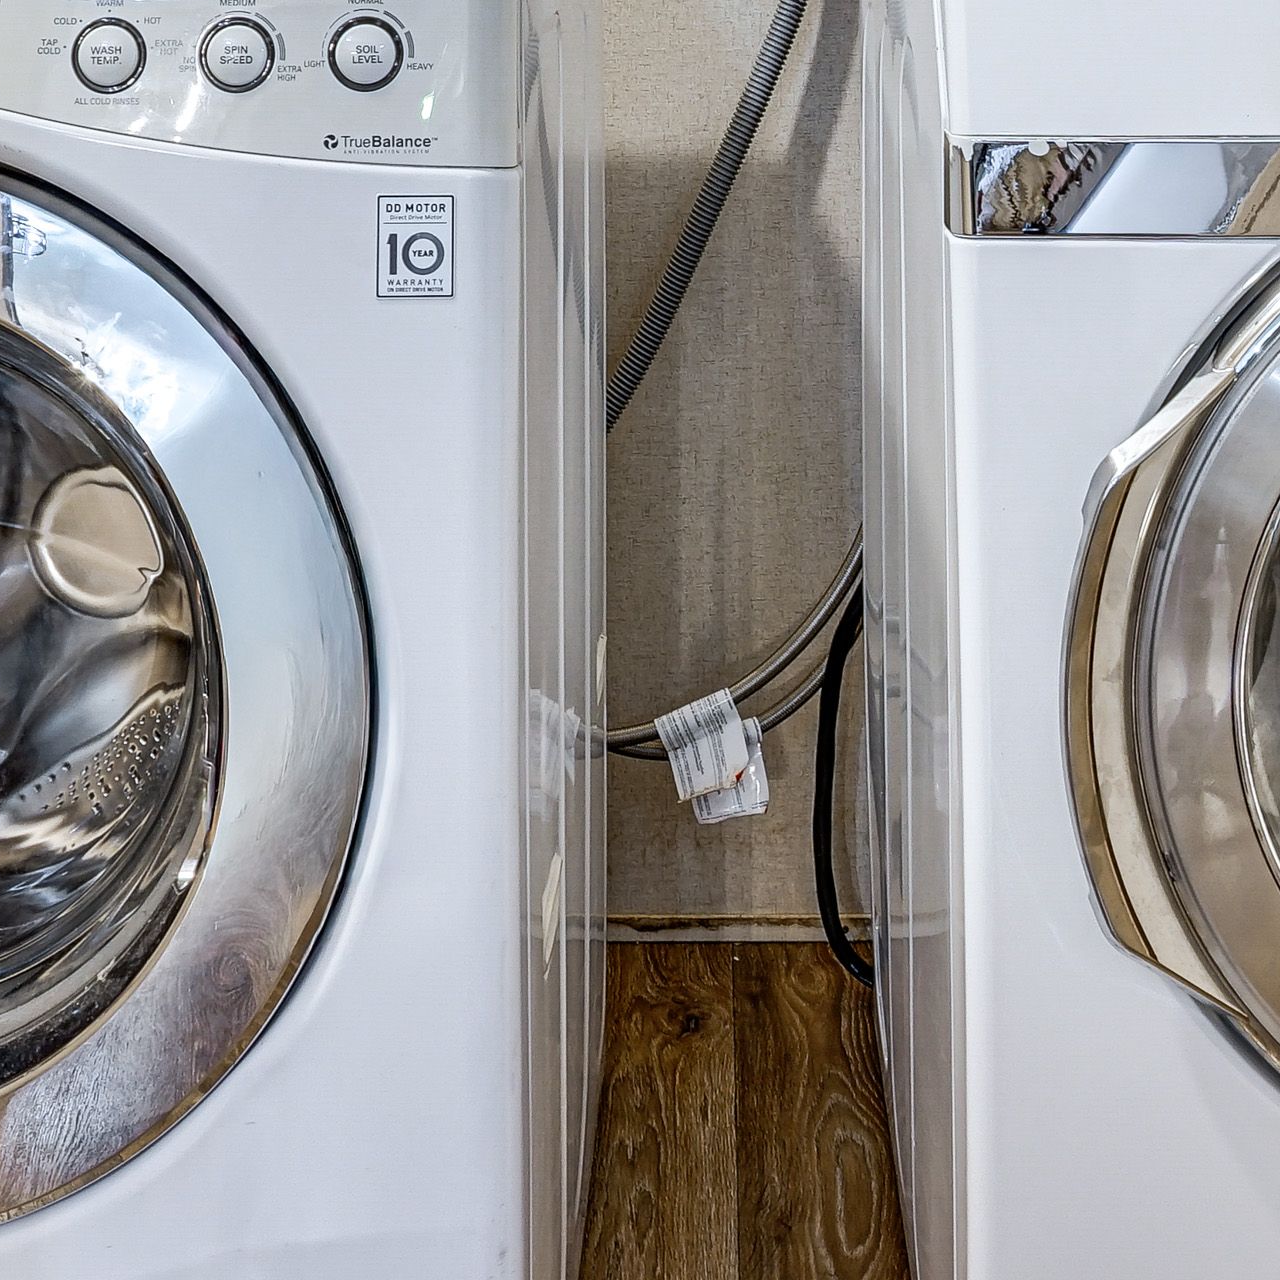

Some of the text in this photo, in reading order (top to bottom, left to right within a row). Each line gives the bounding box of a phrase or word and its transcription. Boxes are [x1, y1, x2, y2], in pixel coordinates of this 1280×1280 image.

[219, 0, 256, 7] MEDIUM
[53, 17, 78, 25] COLD
[155, 39, 183, 47] EXTRA
[37, 47, 61, 55] COLD
[91, 46, 122, 55] WASH
[224, 46, 249, 54] SPIN
[356, 45, 380, 54] SOIL
[91, 56, 122, 65] TEMP.
[219, 55, 253, 65] SPEED
[352, 55, 383, 64] LEVEL
[304, 60, 326, 68] LIGHT
[406, 63, 434, 71] HEAVY
[277, 65, 302, 73] EXTRA
[74, 97, 88, 105] ALL
[386, 203, 446, 213] DD MOTOR
[386, 232, 445, 276] 10
